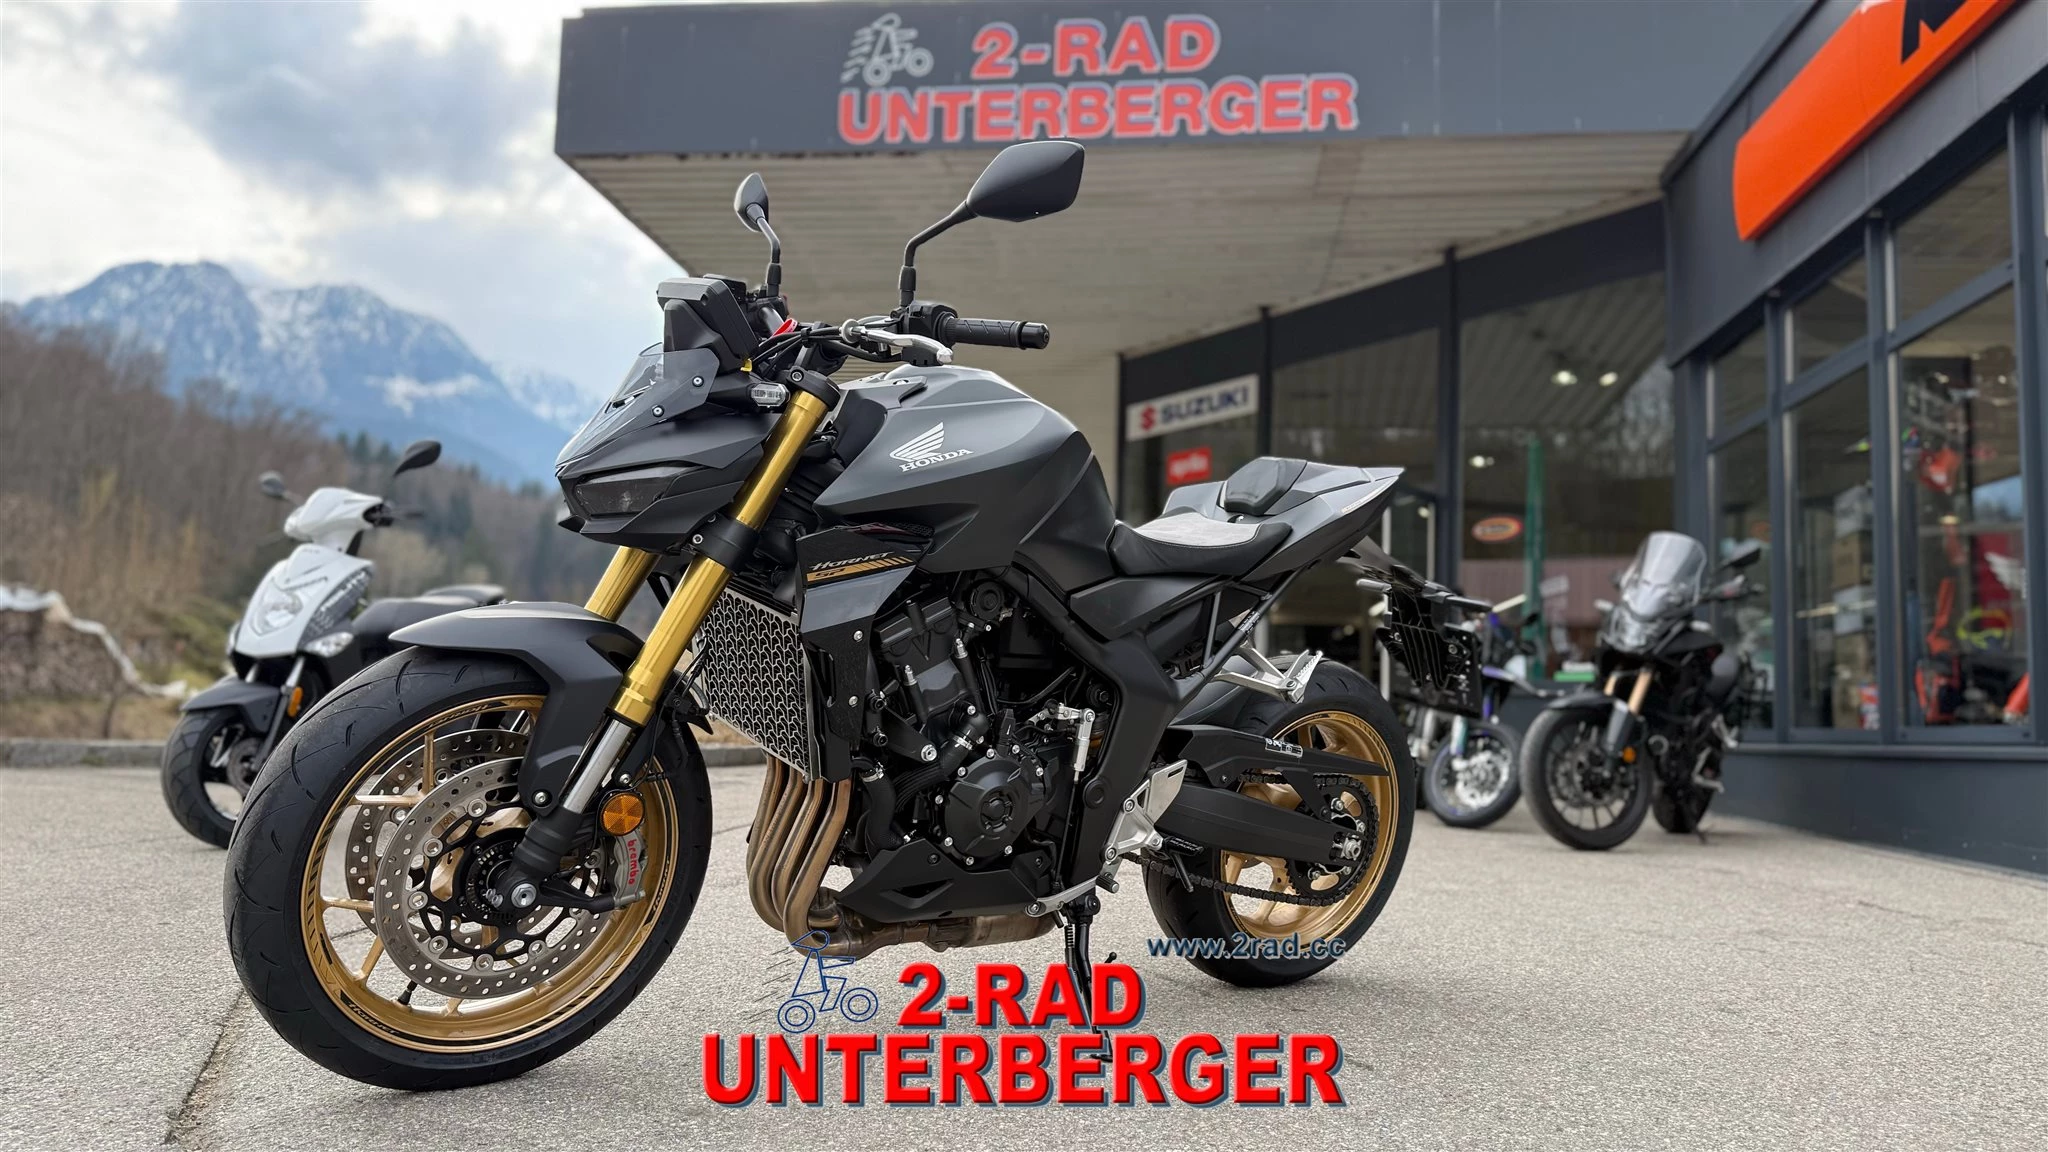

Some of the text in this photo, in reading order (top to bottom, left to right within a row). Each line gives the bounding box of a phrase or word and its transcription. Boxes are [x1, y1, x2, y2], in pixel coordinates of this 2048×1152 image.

[970, 14, 1220, 79] 2-RAD
[838, 73, 1359, 144] UNTERBERGER
[1161, 385, 1249, 425] SUZUKI
[899, 449, 973, 472] HONDA
[627, 839, 639, 886] brembo
